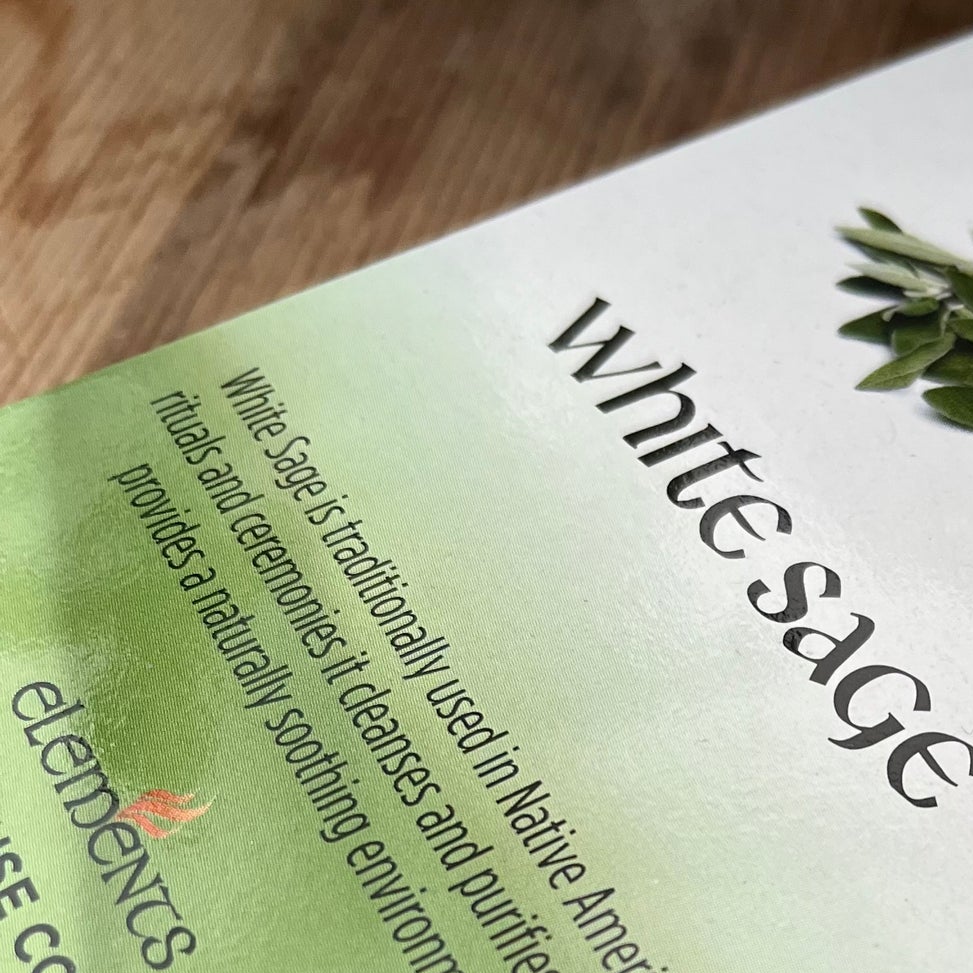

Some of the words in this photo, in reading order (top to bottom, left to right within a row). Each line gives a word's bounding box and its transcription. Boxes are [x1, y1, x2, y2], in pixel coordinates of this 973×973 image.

[151, 391, 226, 465] rituals
[220, 367, 288, 442] White
[198, 463, 265, 514] and
[264, 436, 327, 502] Sage
[107, 464, 205, 570] provides
[305, 494, 348, 525] is
[180, 567, 216, 591] a
[230, 513, 347, 659] ceremonies
[322, 520, 450, 680] traditionally
[192, 588, 293, 709] naturally
[321, 651, 370, 685] it
[339, 683, 441, 806] cleanses
[426, 679, 509, 753] used
[265, 709, 370, 843] soothing
[473, 745, 521, 788] in
[416, 804, 494, 871] and
[496, 780, 586, 890] Native
